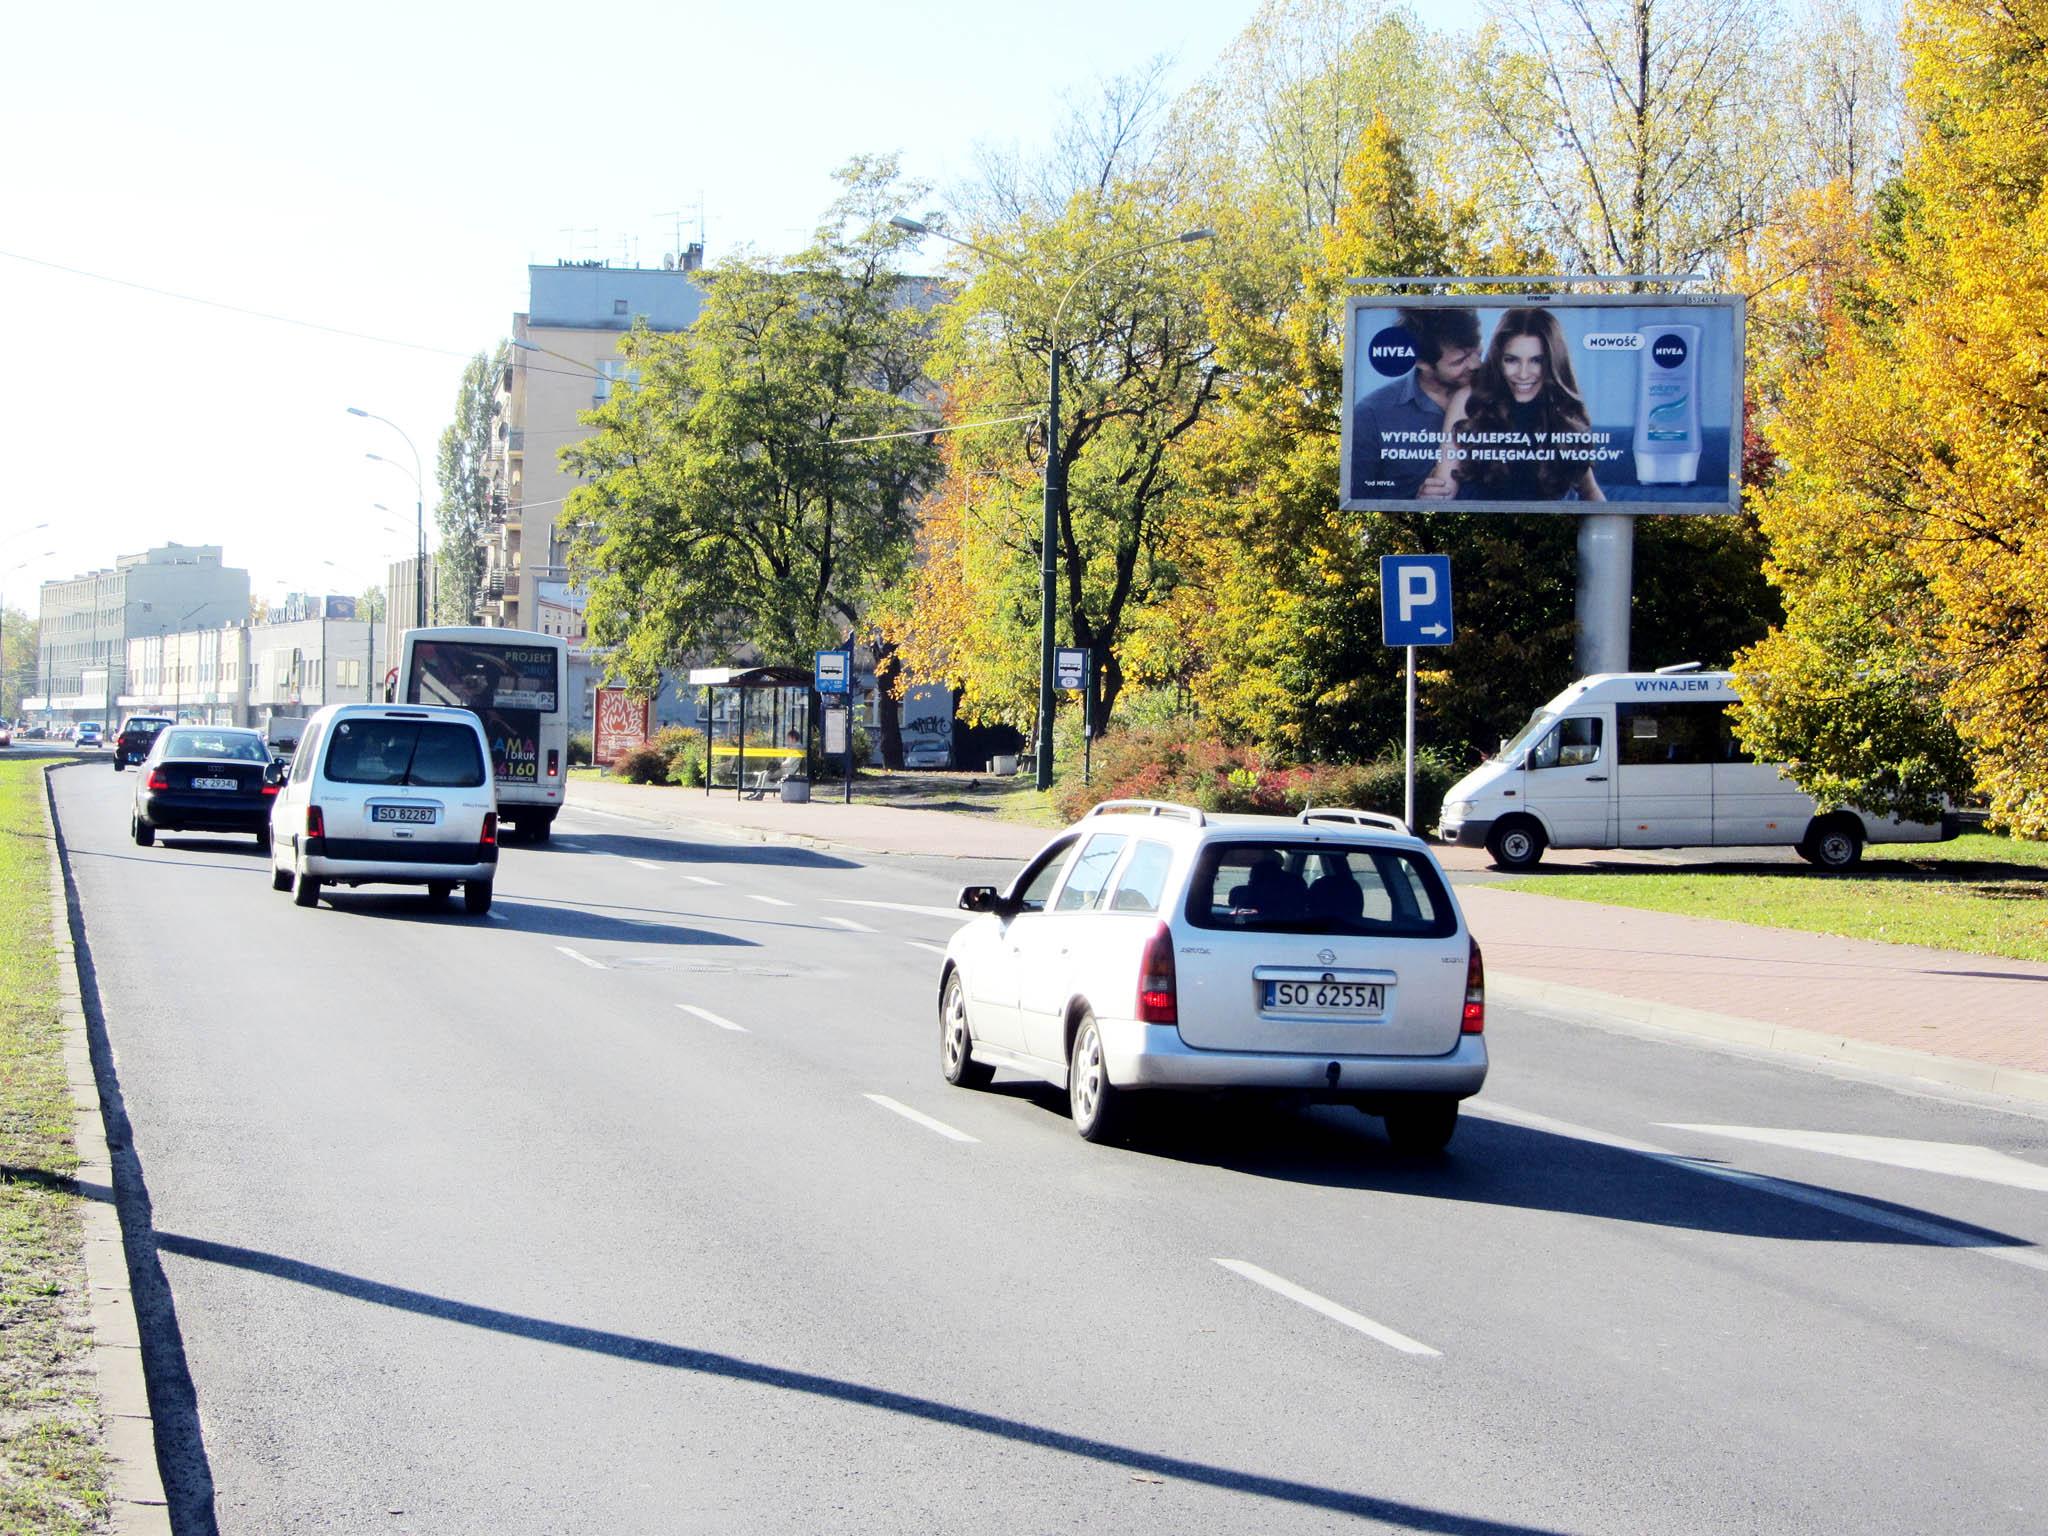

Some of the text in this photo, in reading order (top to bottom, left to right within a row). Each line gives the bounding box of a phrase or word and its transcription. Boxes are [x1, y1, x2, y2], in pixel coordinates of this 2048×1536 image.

[1589, 335, 1638, 347] NOWOŚĆ
[1372, 346, 1416, 357] NIVEA
[1655, 347, 1684, 356] NIVEA
[1380, 429, 1610, 446] WYPRÓBUJ NAJLEPSZĄ W HISTORII
[1380, 448, 1443, 463] FORMUŁĘ
[1446, 449, 1467, 460] DO
[1471, 449, 1555, 464] PIELĘGNACJI
[1398, 566, 1437, 621] P
[505, 651, 552, 663] PROJEKT
[1635, 680, 1709, 692] WYNAJEM
[511, 751, 536, 761] DRUK
[379, 808, 433, 820] SO 82287
[1279, 984, 1379, 1008] SO 6255A
